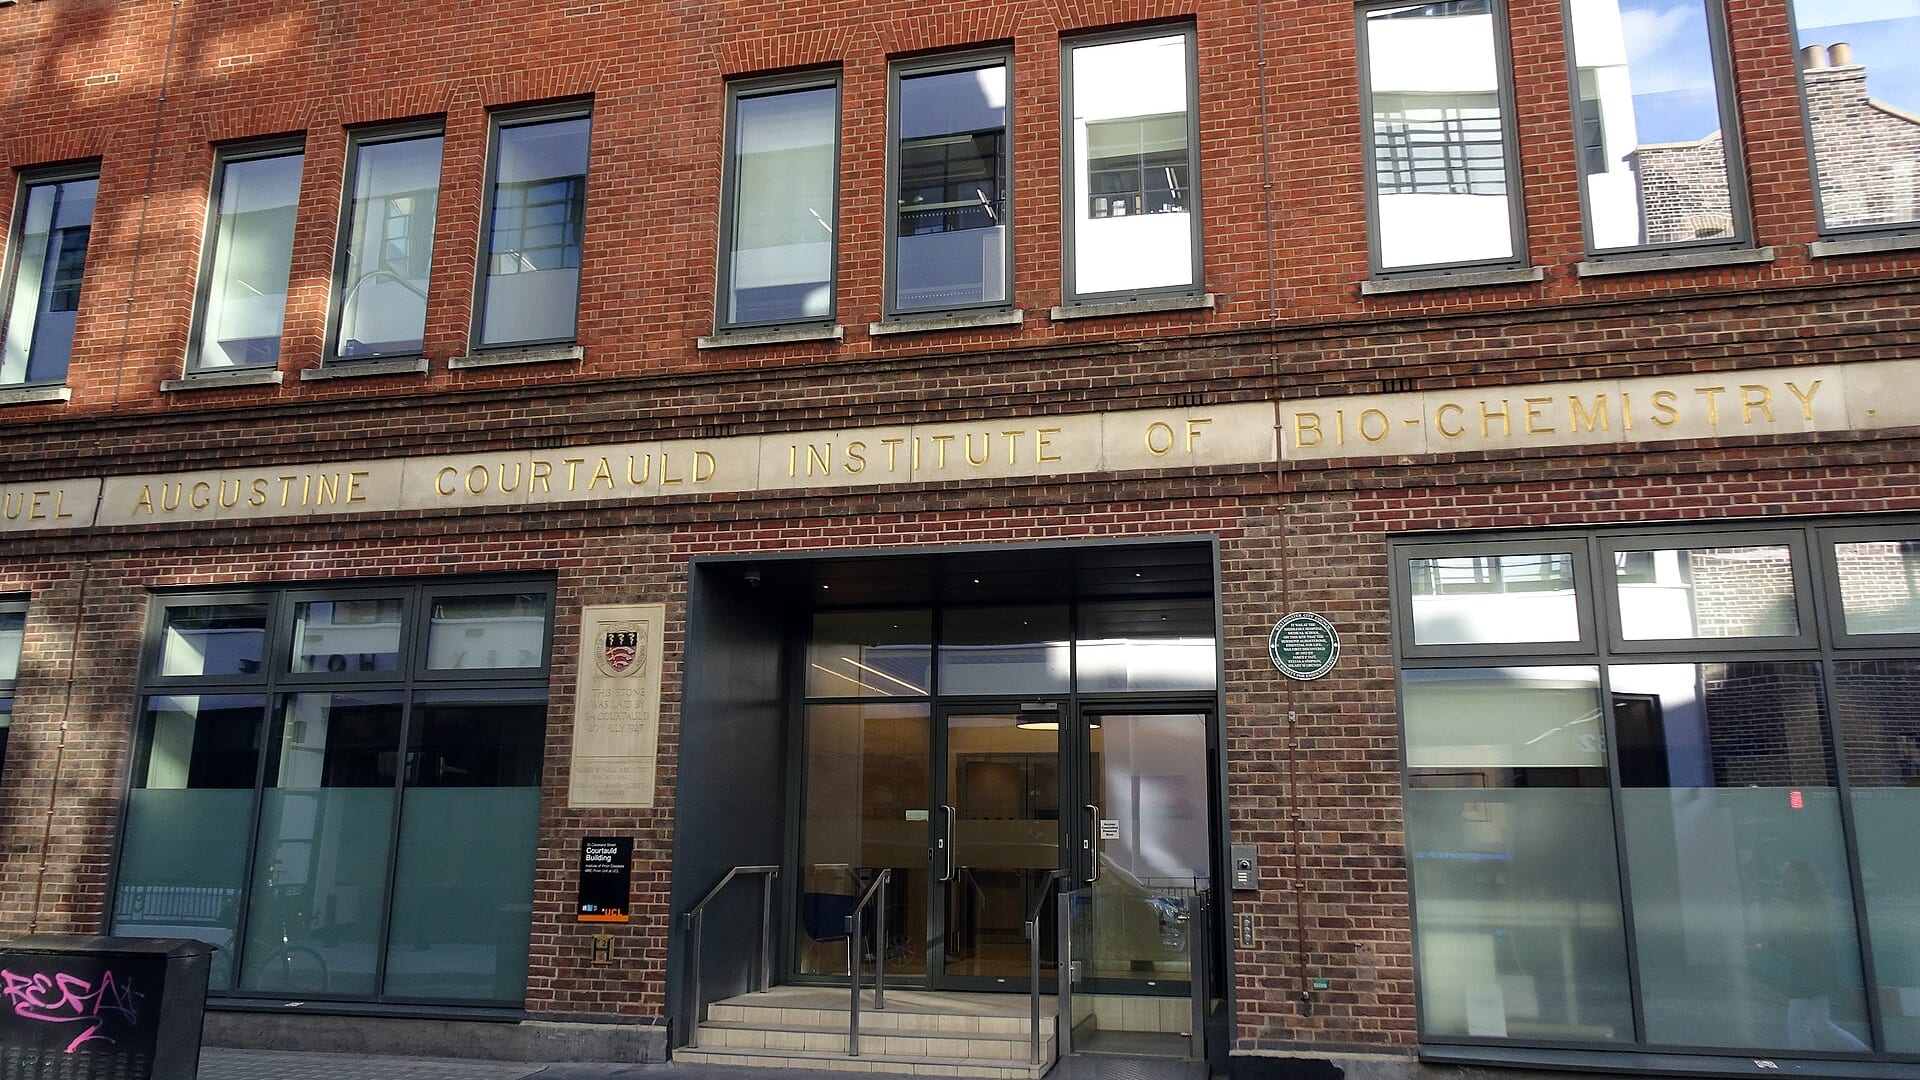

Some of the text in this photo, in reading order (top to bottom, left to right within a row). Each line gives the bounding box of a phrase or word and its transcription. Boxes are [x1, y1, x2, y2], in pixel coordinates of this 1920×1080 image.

[132, 471, 370, 516] AUGUSTINE
[434, 450, 717, 497] COURTAULD
[788, 427, 1063, 478] INSTITUTE
[1144, 418, 1213, 457] OF
[1295, 379, 1823, 448] BIO-CHEMISTRY
[586, 854, 612, 862] Building
